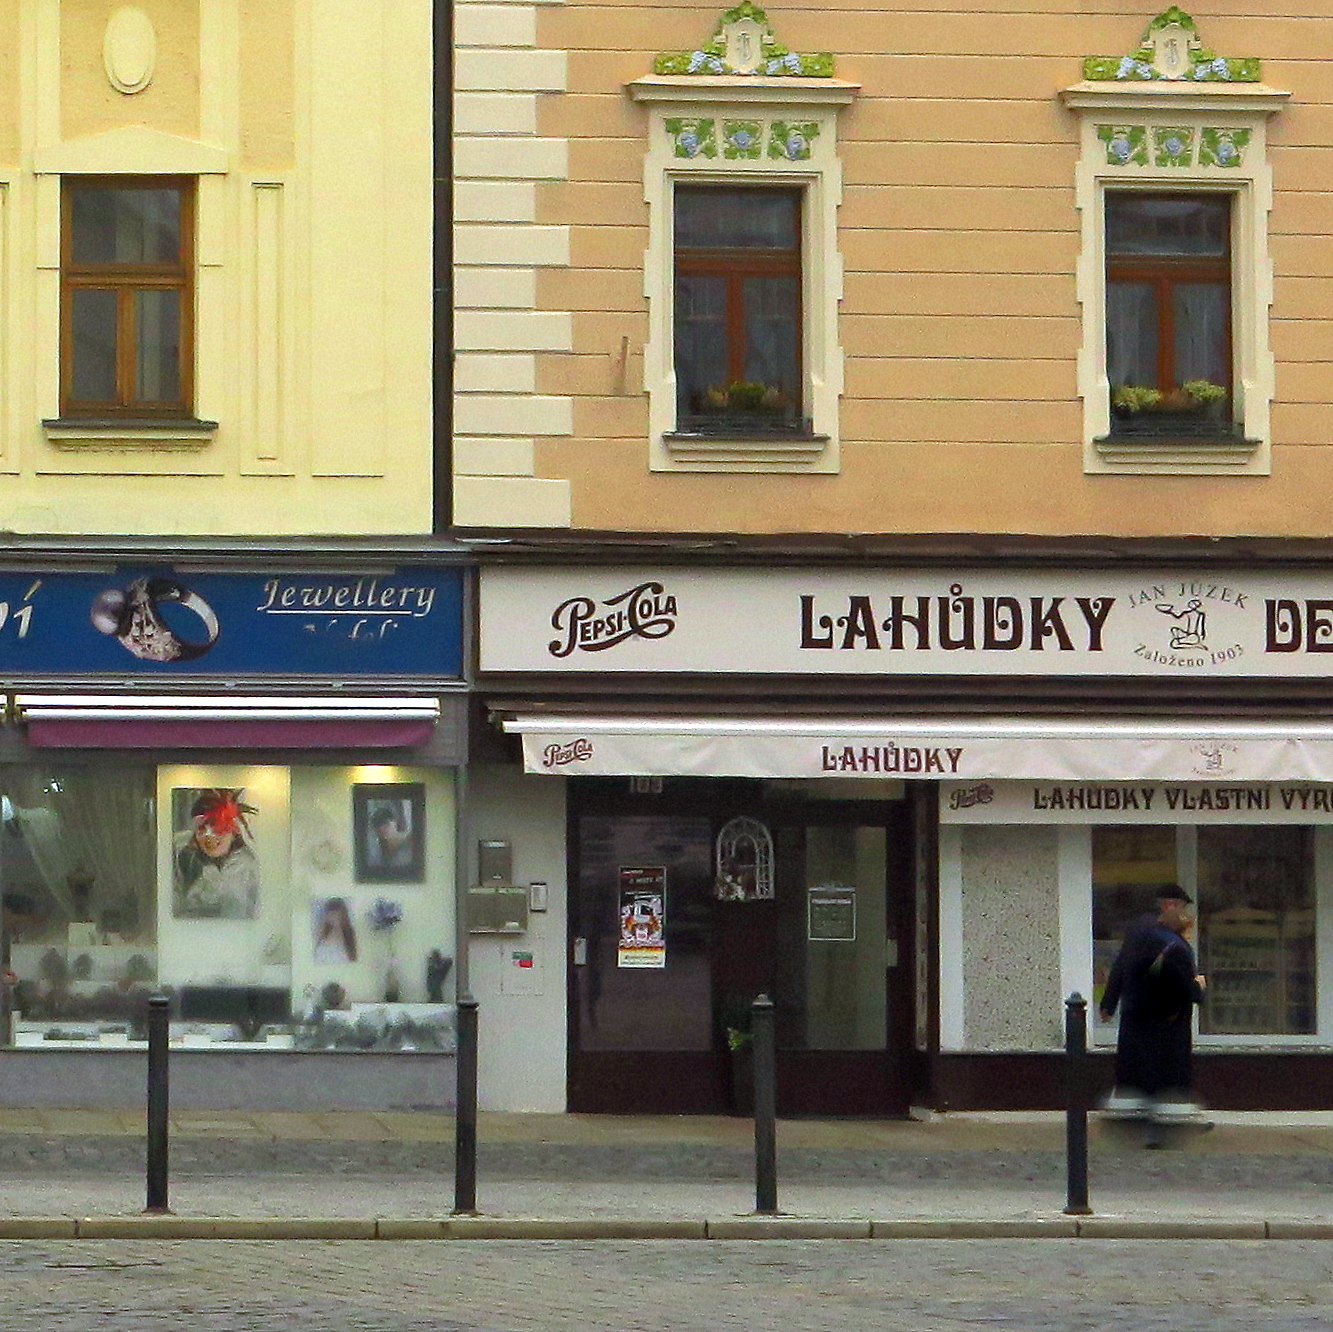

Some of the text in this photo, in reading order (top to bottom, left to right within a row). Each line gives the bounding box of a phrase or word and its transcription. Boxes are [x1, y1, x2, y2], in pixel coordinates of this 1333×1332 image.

[256, 578, 437, 617] Jewellery
[1129, 584, 1166, 609] JAN
[799, 583, 1117, 651] LAHŮDKY
[1133, 642, 1205, 668] Založeno
[822, 741, 964, 773] LAHŮDKY
[1280, 783, 1333, 812] VÝR
